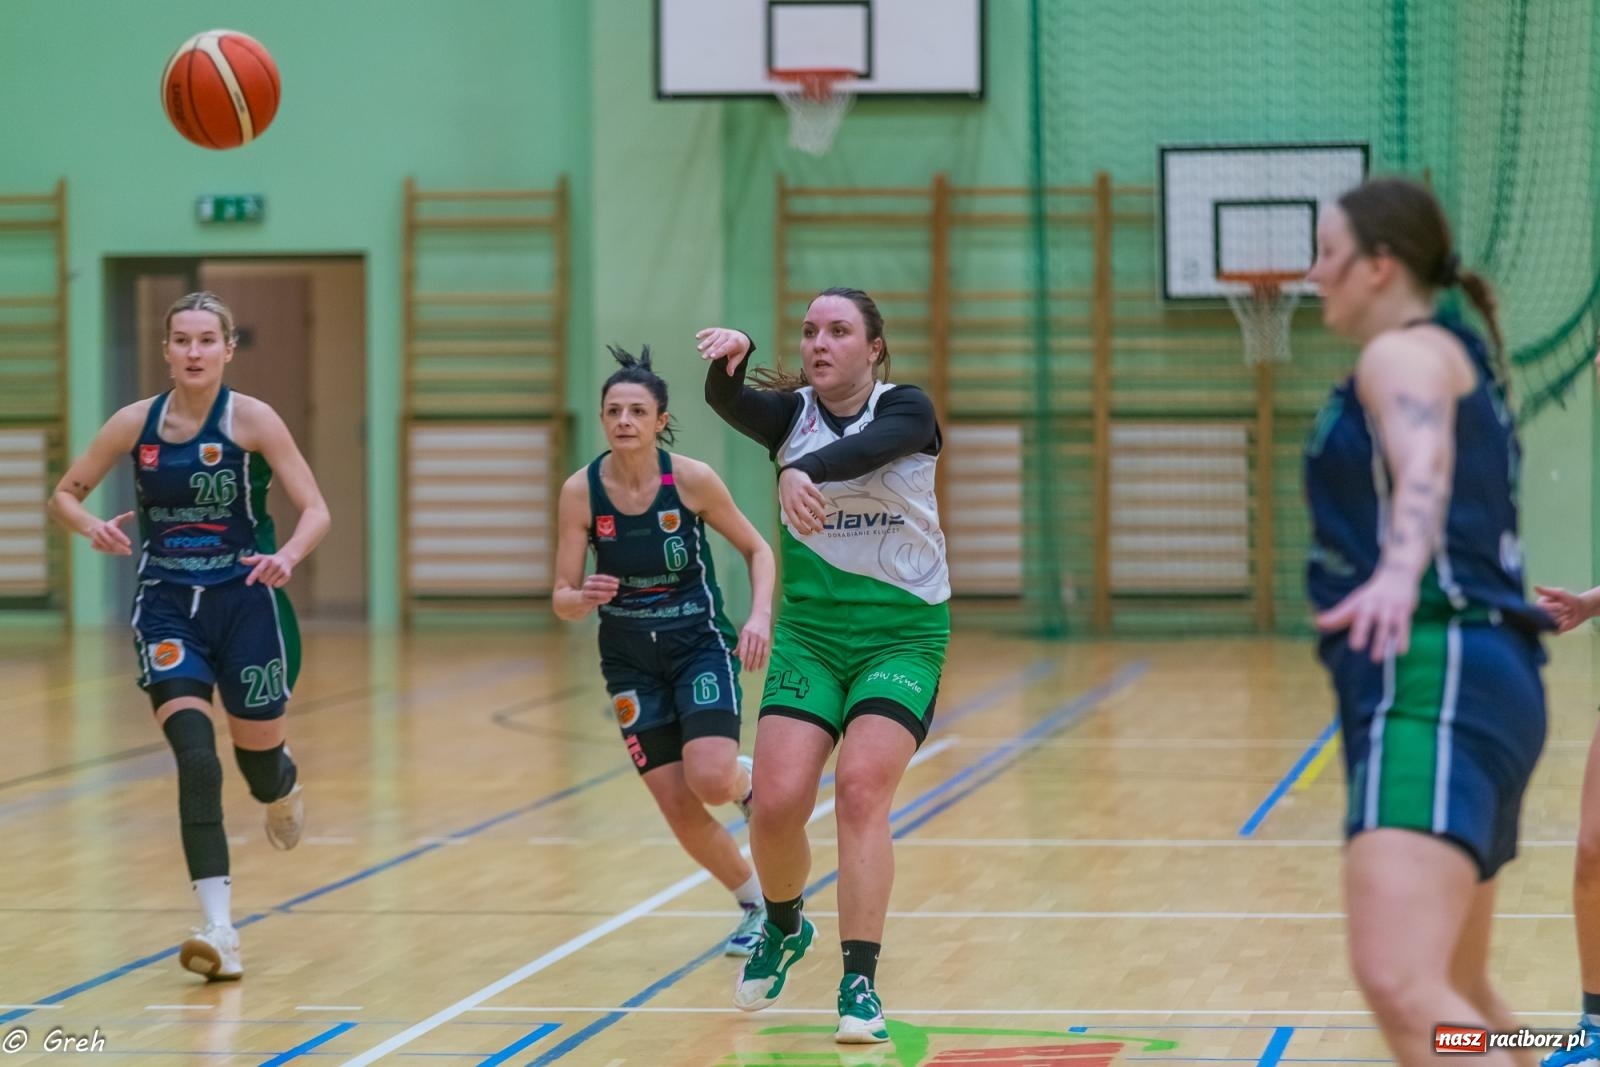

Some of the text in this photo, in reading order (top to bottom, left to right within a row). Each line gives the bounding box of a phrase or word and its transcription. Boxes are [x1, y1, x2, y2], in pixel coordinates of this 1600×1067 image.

[190, 469, 237, 506] 26
[664, 536, 688, 572] 6
[241, 659, 283, 708] 26
[692, 671, 720, 705] 6
[762, 669, 810, 700] 24
